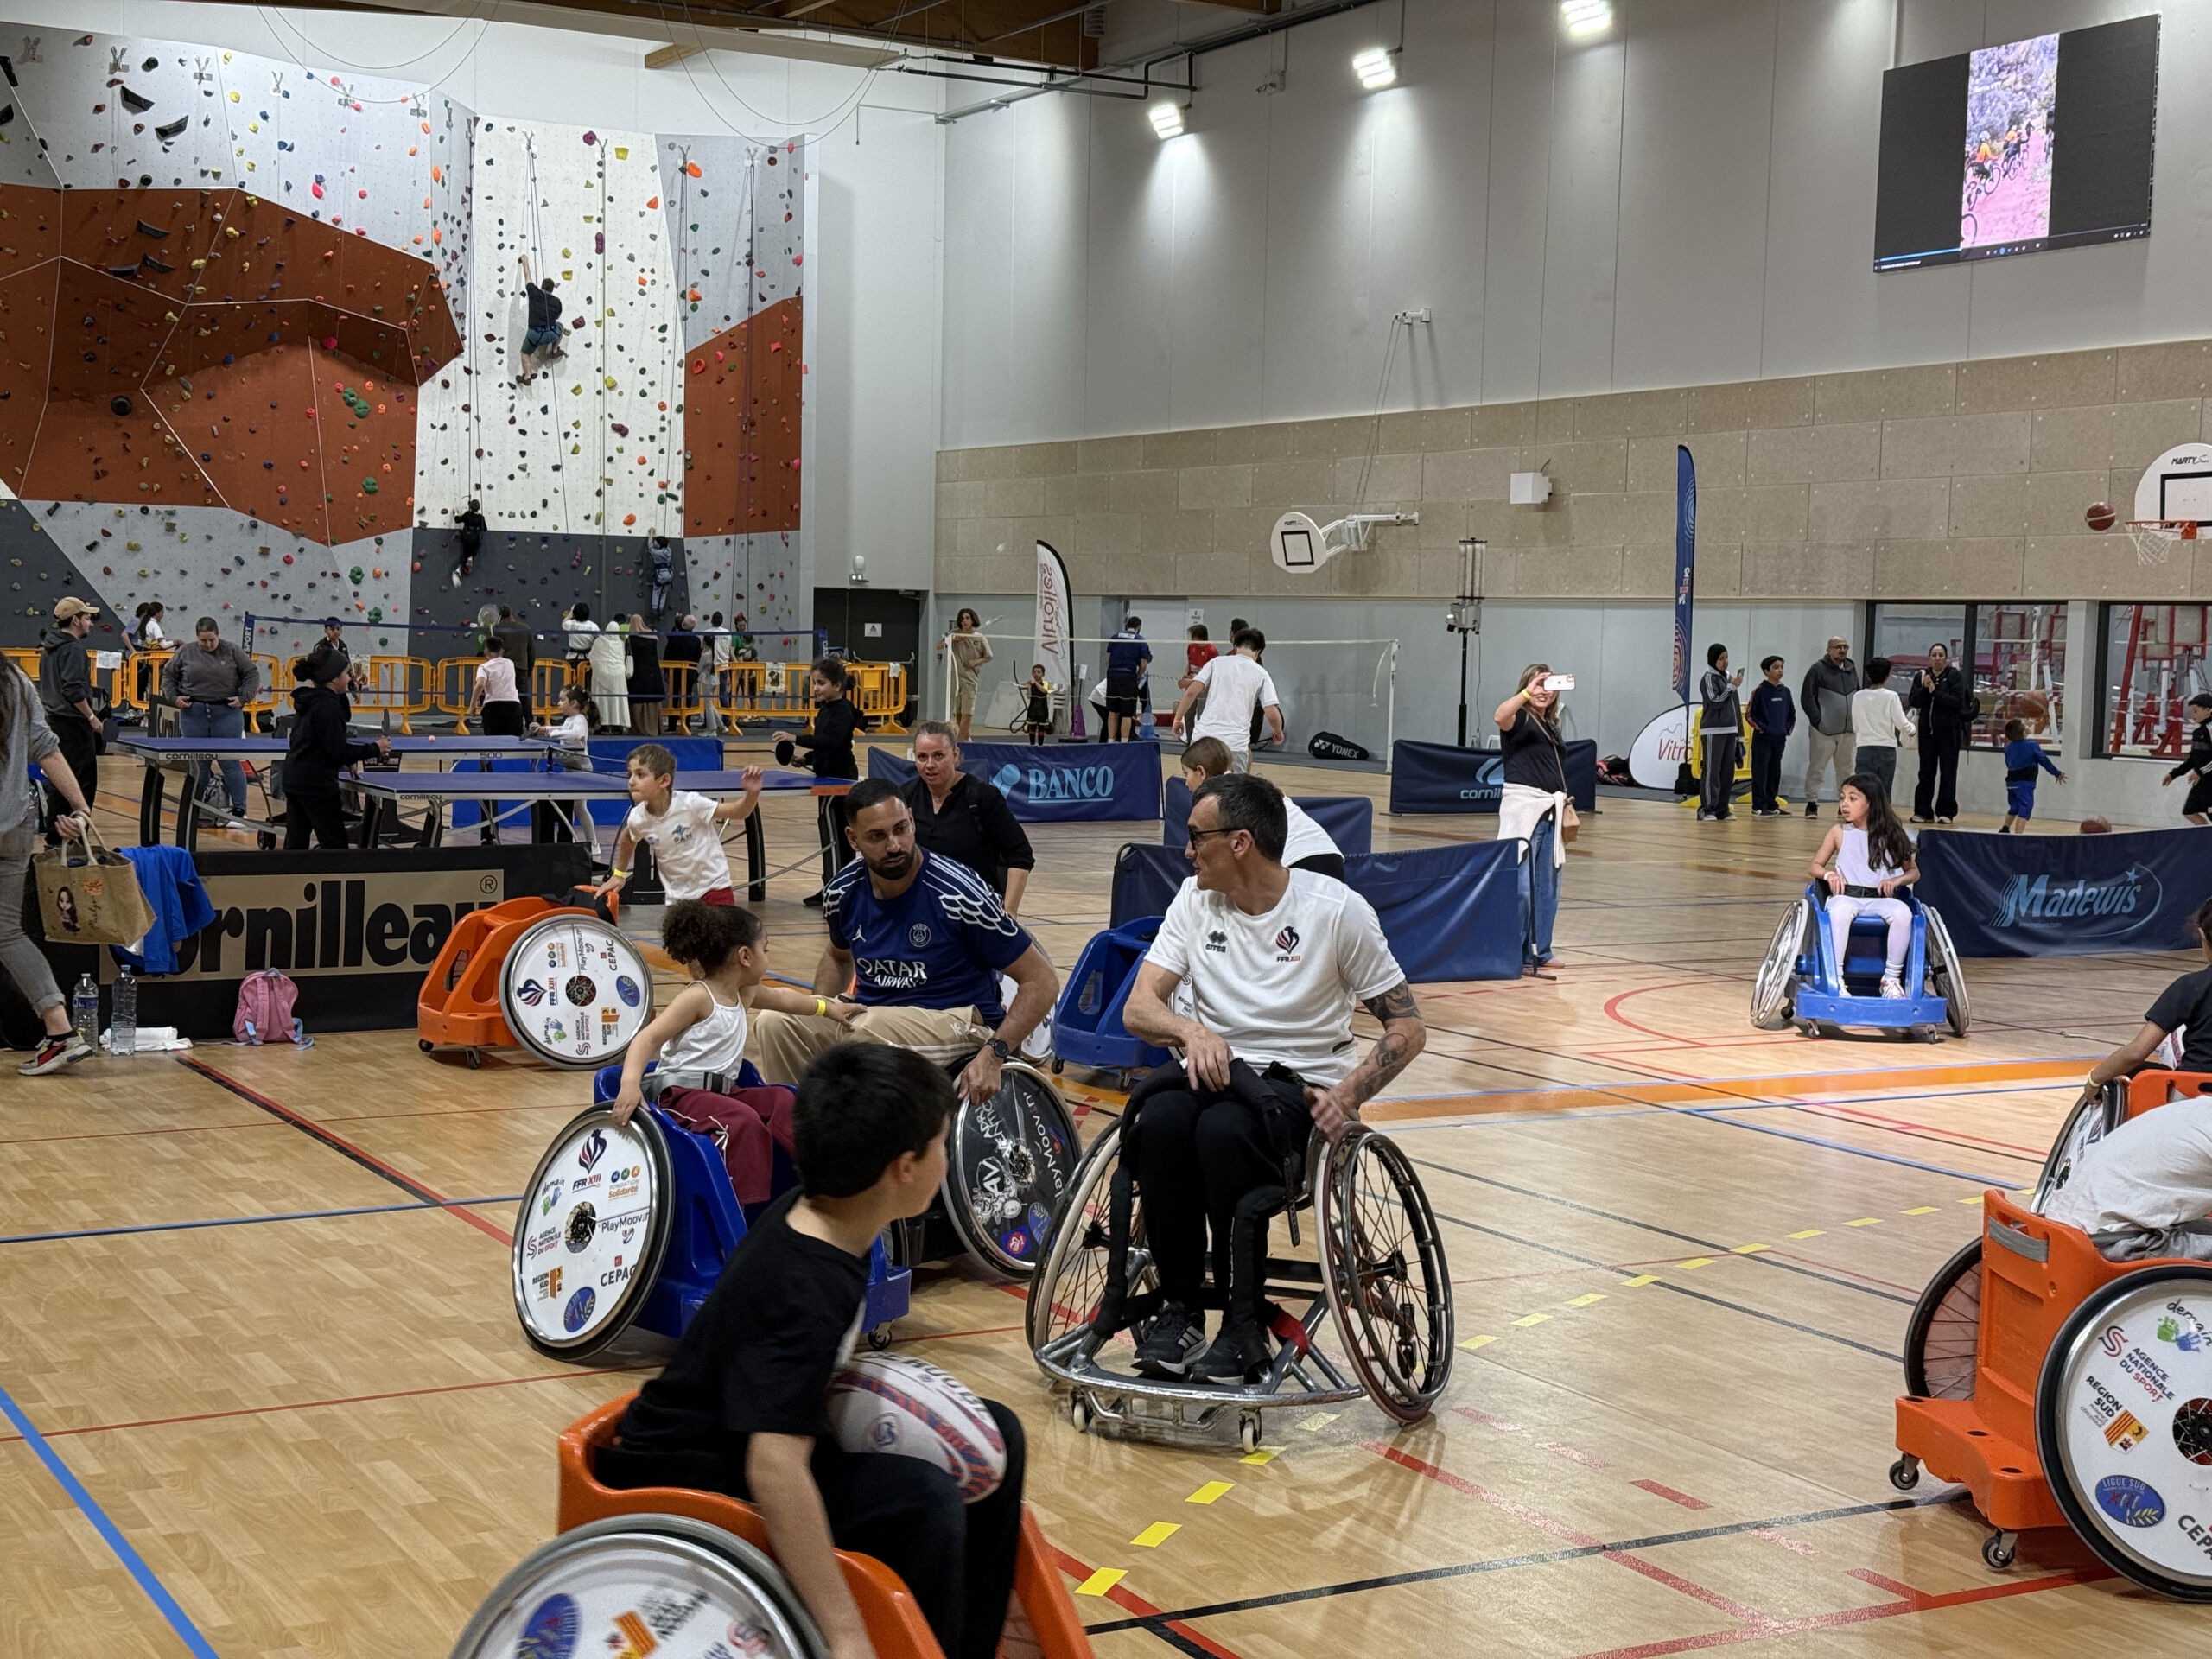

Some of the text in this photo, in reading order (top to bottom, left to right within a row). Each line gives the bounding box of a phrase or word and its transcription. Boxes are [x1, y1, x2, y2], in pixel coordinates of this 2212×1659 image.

[2171, 456, 2196, 465] MARTY
[244, 626, 252, 652] SPORT
[1332, 743, 1359, 759] YONEX
[1028, 766, 1115, 799] BANCO
[1989, 874, 2142, 927] Madewis
[109, 880, 497, 976] rnillea
[606, 939, 618, 971] CEPAC
[856, 957, 928, 979] QATAR
[572, 1173, 602, 1191] FFR XIII
[2126, 1352, 2176, 1401] NATIONALE
[2132, 1347, 2170, 1382] AGENCE
[2119, 1359, 2164, 1402] DU SPORT
[2094, 1397, 2115, 1418] SUD
[2102, 1478, 2126, 1488] LIGUE
[2129, 1478, 2146, 1491] SUD
